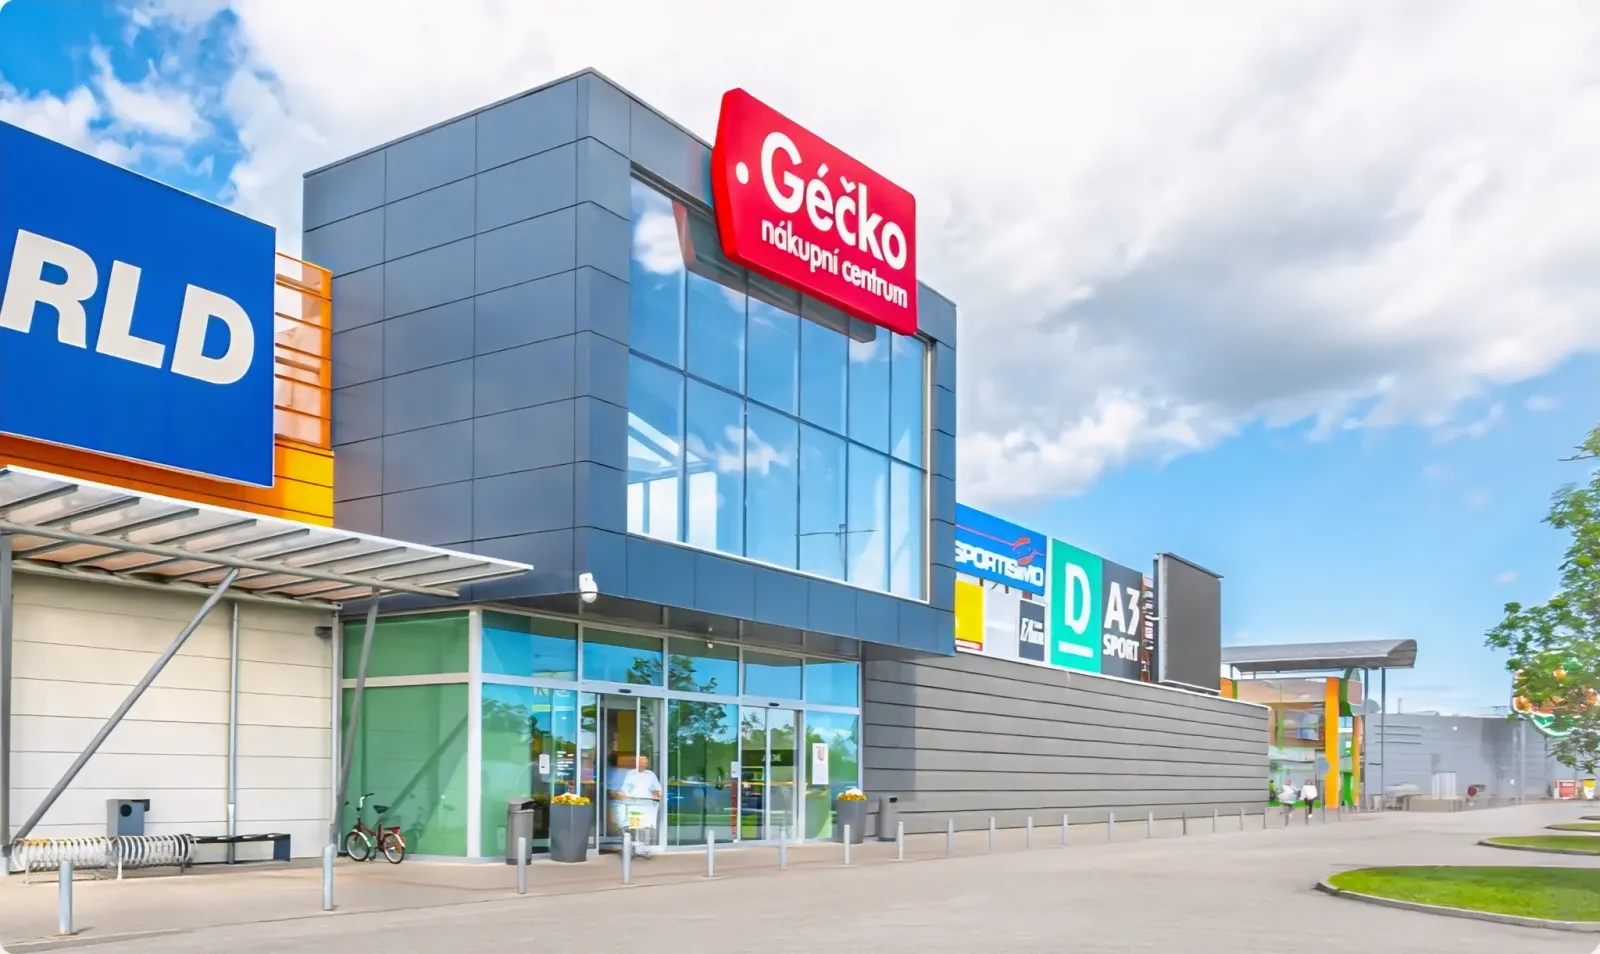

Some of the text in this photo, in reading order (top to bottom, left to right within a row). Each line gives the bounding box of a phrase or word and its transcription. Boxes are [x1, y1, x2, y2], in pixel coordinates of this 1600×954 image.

[761, 132, 907, 270] Géčko
[761, 219, 908, 309] nákupní centrum
[0, 228, 255, 385] RLD
[1064, 562, 1091, 634] D
[1103, 581, 1140, 636] A3
[1103, 633, 1140, 662] SPORT
